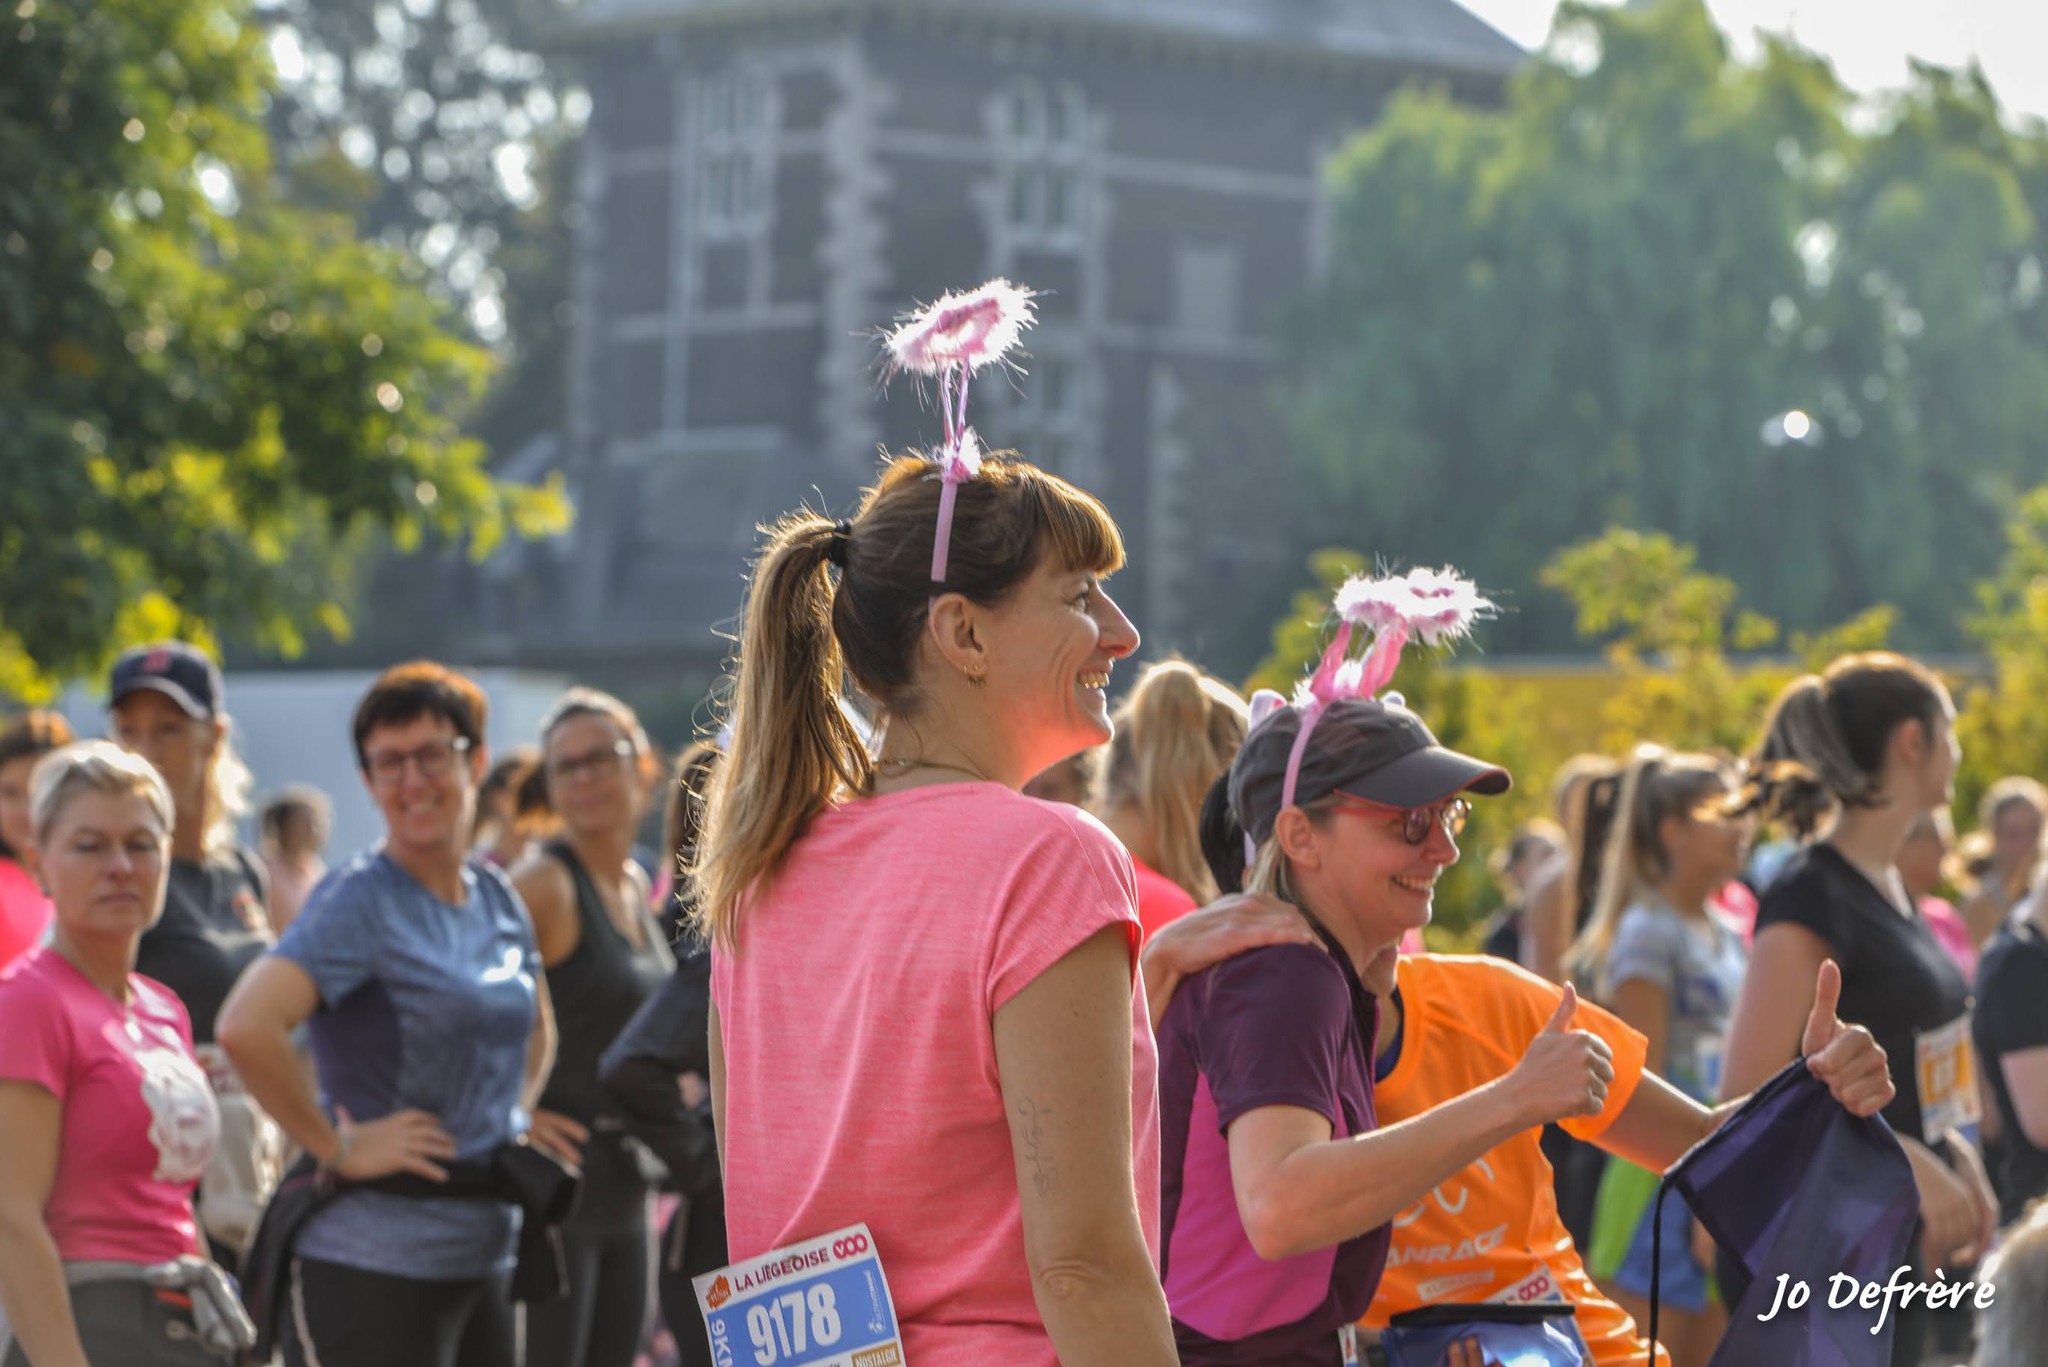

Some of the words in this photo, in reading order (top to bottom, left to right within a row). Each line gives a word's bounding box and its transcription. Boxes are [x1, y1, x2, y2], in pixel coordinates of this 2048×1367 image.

[734, 1274, 754, 1293] LA
[833, 1233, 869, 1260] VOO
[746, 1282, 842, 1367] 9178
